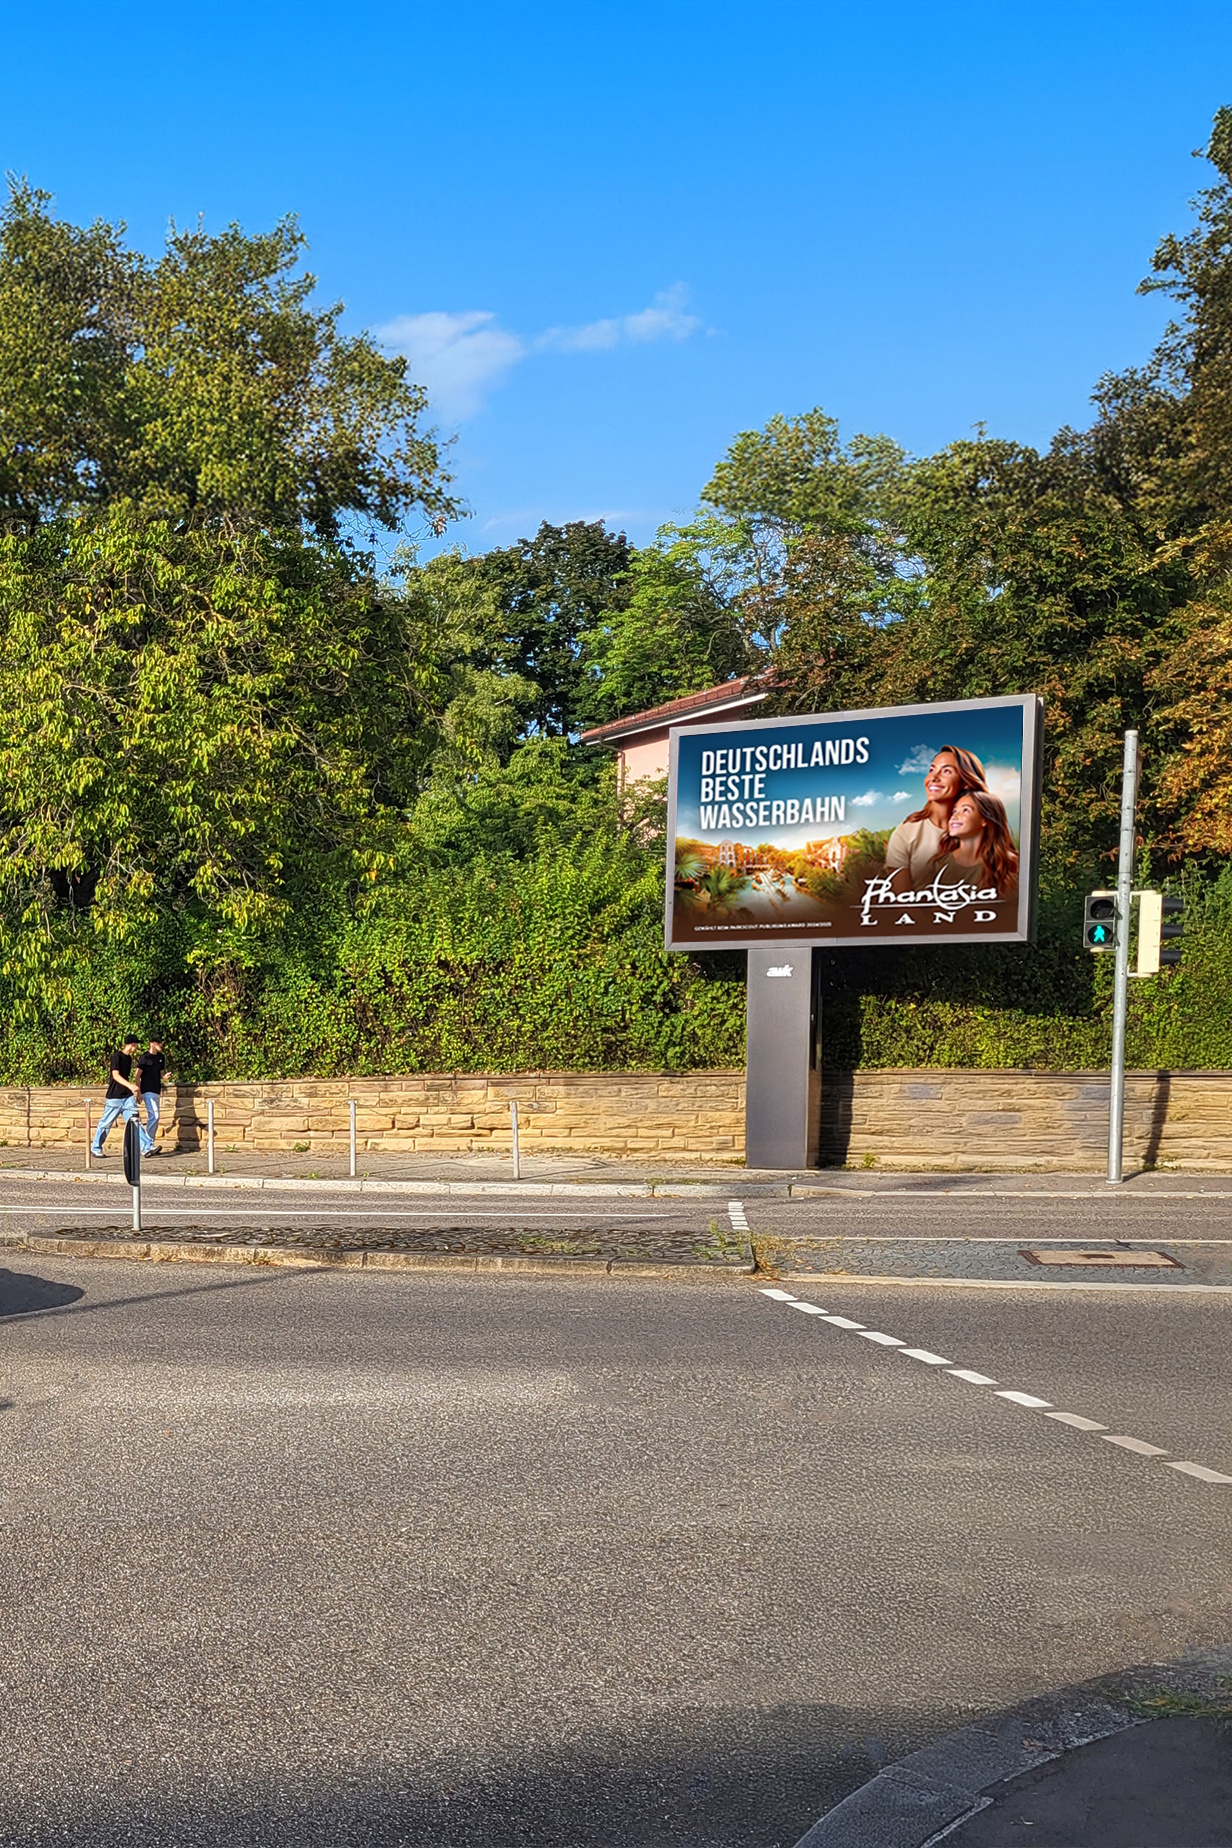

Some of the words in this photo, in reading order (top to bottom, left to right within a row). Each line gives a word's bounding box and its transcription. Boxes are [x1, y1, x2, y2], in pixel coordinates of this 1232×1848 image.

[701, 737, 870, 776] DEUTSCHLANDS
[700, 773, 766, 802] BESTE
[700, 795, 846, 830] WASSERBAHN
[861, 864, 998, 915] Phantasia
[860, 910, 997, 926] LAND
